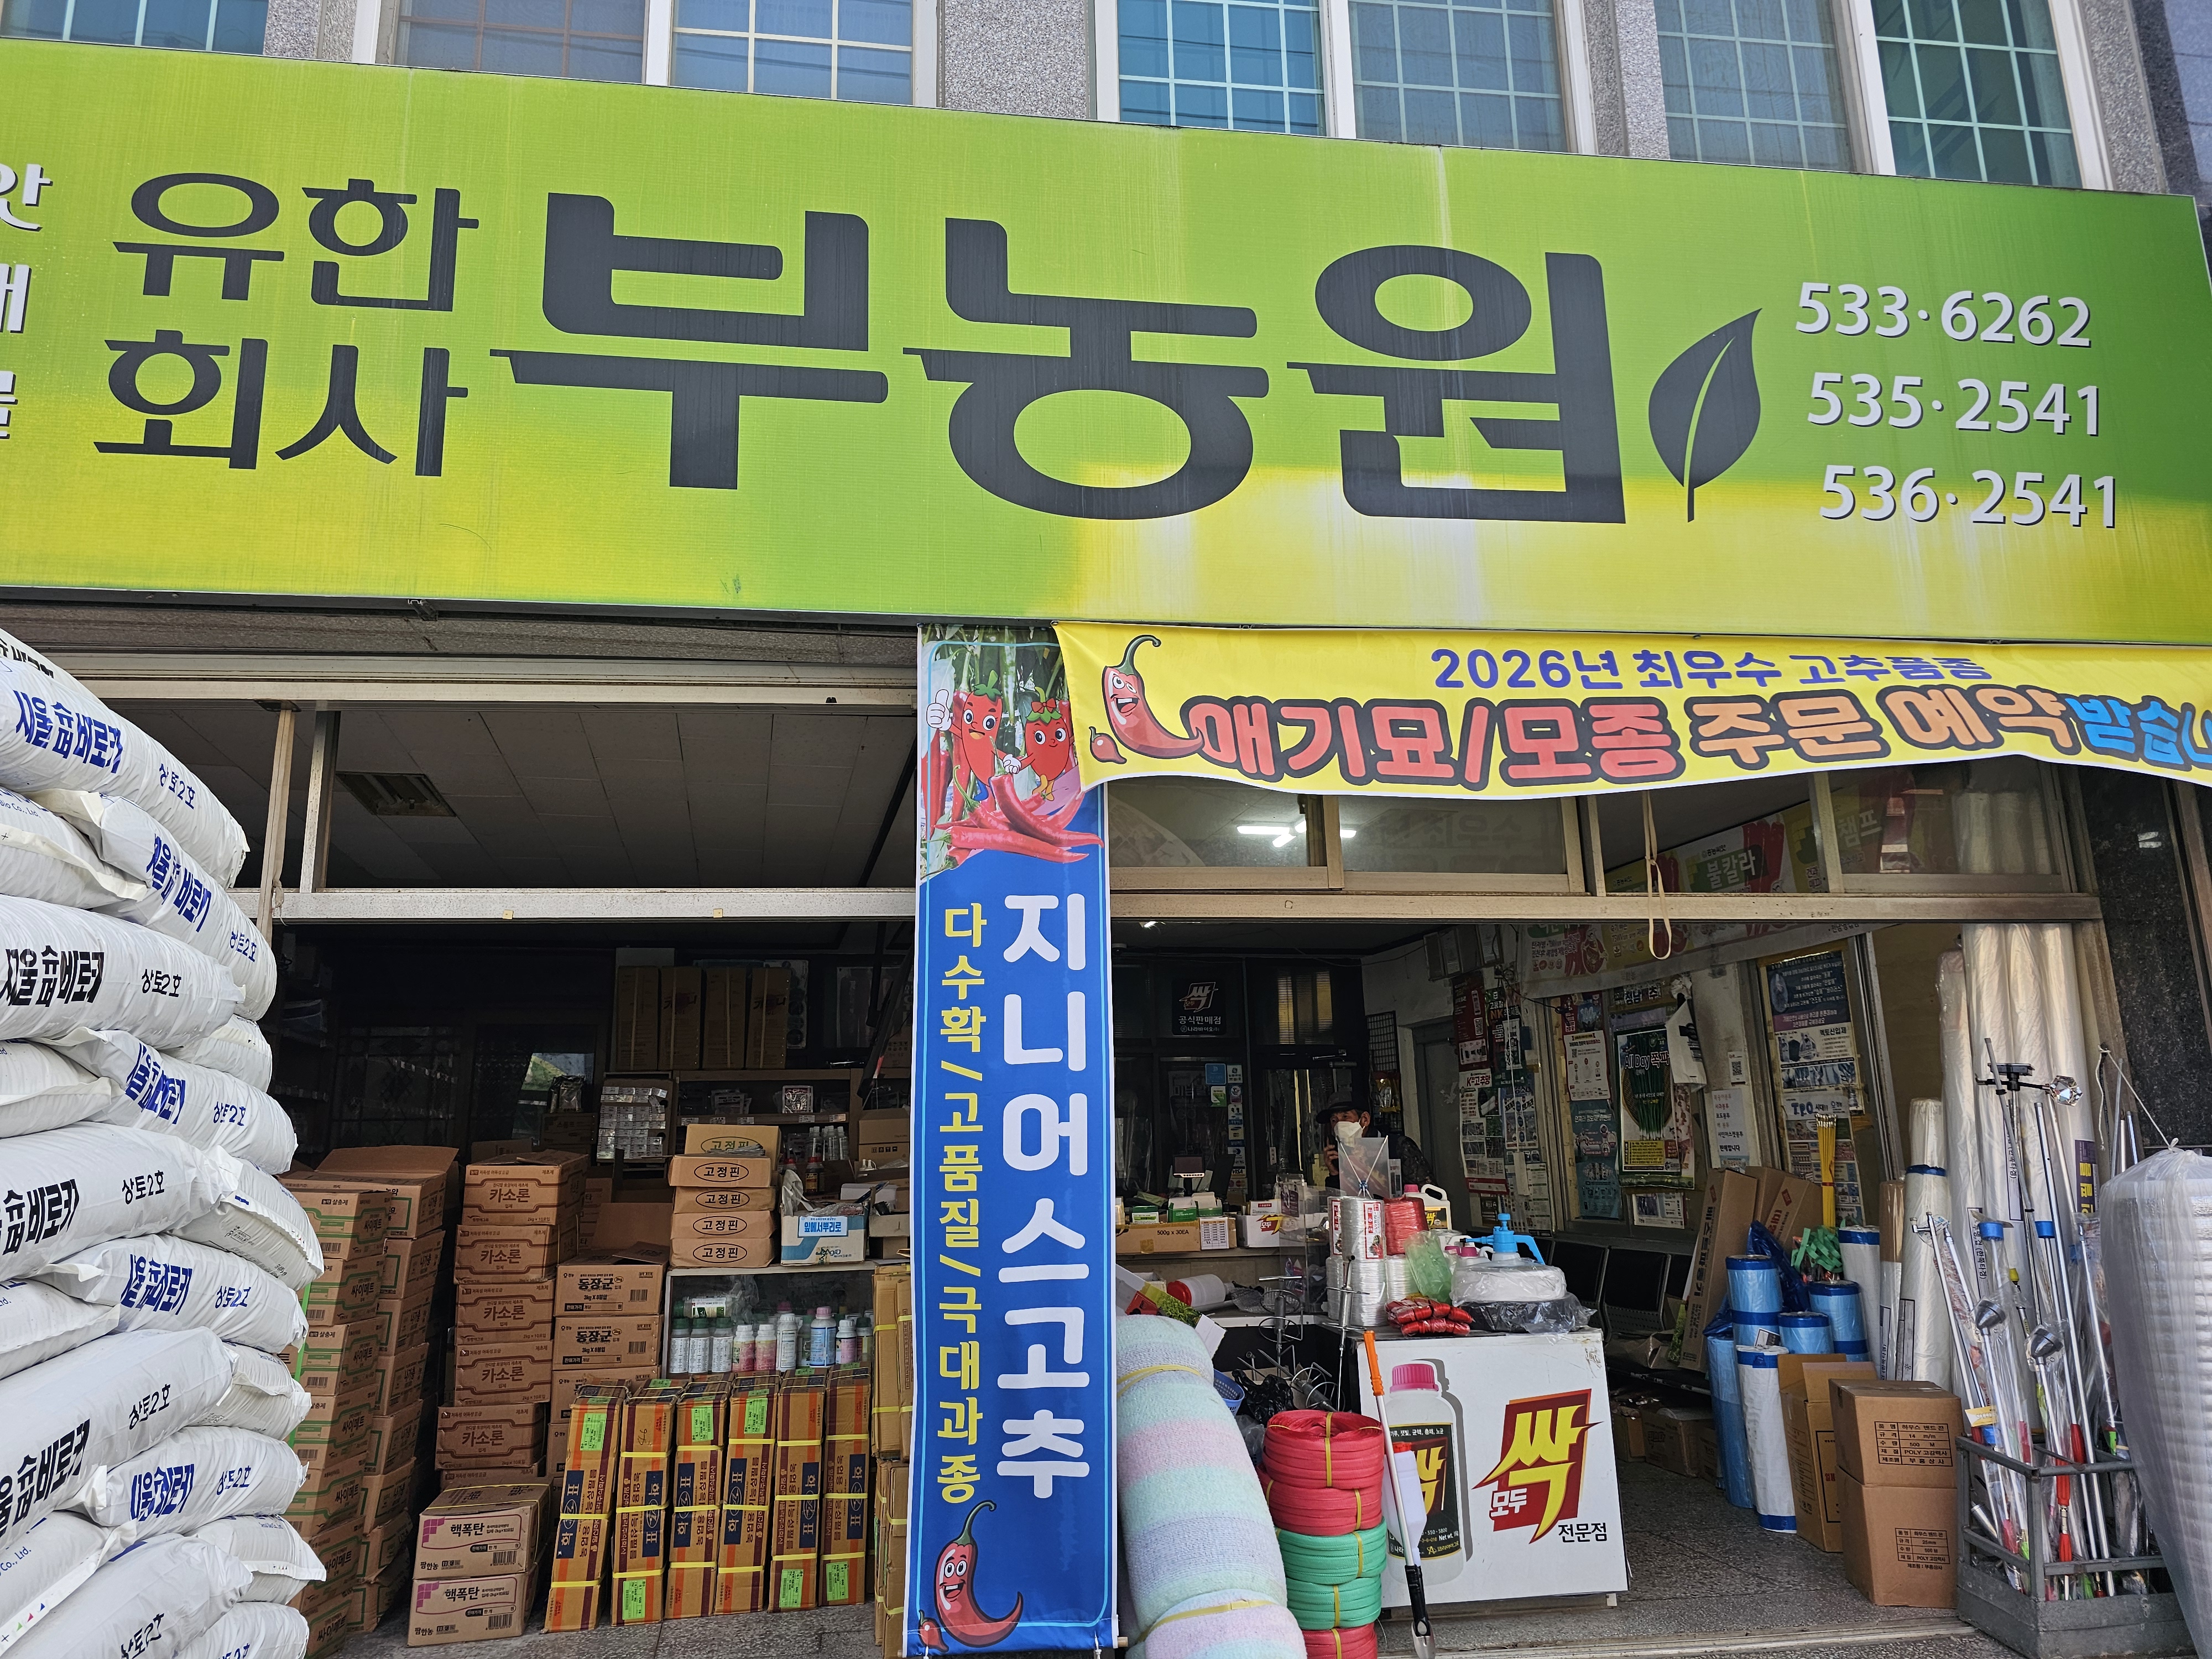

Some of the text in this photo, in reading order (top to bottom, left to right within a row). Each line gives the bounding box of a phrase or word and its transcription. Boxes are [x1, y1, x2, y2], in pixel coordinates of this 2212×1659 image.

[113, 172, 479, 312] 유한
[490, 192, 1626, 524] 부농원
[93, 329, 468, 477] 회사
[1430, 648, 1993, 691] 2026년 최우수 고추품종
[1182, 697, 1683, 791] 애기묘/모종
[1687, 690, 1891, 770] 주문
[1878, 685, 2080, 754] 예약
[159, 763, 196, 810] 상토2호
[1705, 848, 1756, 889] 불칼라
[229, 930, 258, 962] 상토2호
[141, 968, 182, 998] 상토2호
[1489, 1000, 1504, 1010] 고품질
[1178, 1016, 1222, 1025] 공식판매점
[1490, 1009, 1504, 1020] NK
[1624, 1051, 1670, 1070] All Day 쪽파
[213, 1101, 247, 1127] 상토2호
[703, 1165, 740, 1178] 고정핀
[122, 1170, 165, 1205] 상토2호
[489, 1188, 530, 1203] 카소론
[997, 893, 1091, 1499] 지니어스고추
[704, 1192, 742, 1205] 고정핀
[701, 1218, 738, 1231] 고정핀
[804, 1222, 842, 1233] 잎에서뿌리로
[480, 1249, 521, 1265] 카소론
[701, 1245, 738, 1259] 고정핀
[351, 1282, 375, 1298] 싸이메트
[577, 1277, 614, 1290] 동장군
[483, 1305, 526, 1321] 카소론
[575, 1329, 613, 1343] 동장군
[481, 1366, 525, 1383] 카소론
[129, 1383, 171, 1430] 상토2호
[462, 1430, 505, 1447] 카소론
[1482, 1403, 1590, 1541] 싹
[1491, 1487, 1527, 1517] 모두
[450, 1522, 485, 1537] 핵폭탄
[1558, 1522, 1608, 1543] 전문점
[420, 1561, 439, 1571] 팜한농
[444, 1586, 480, 1603] 핵폭탄
[414, 1627, 434, 1636] 팜한농
